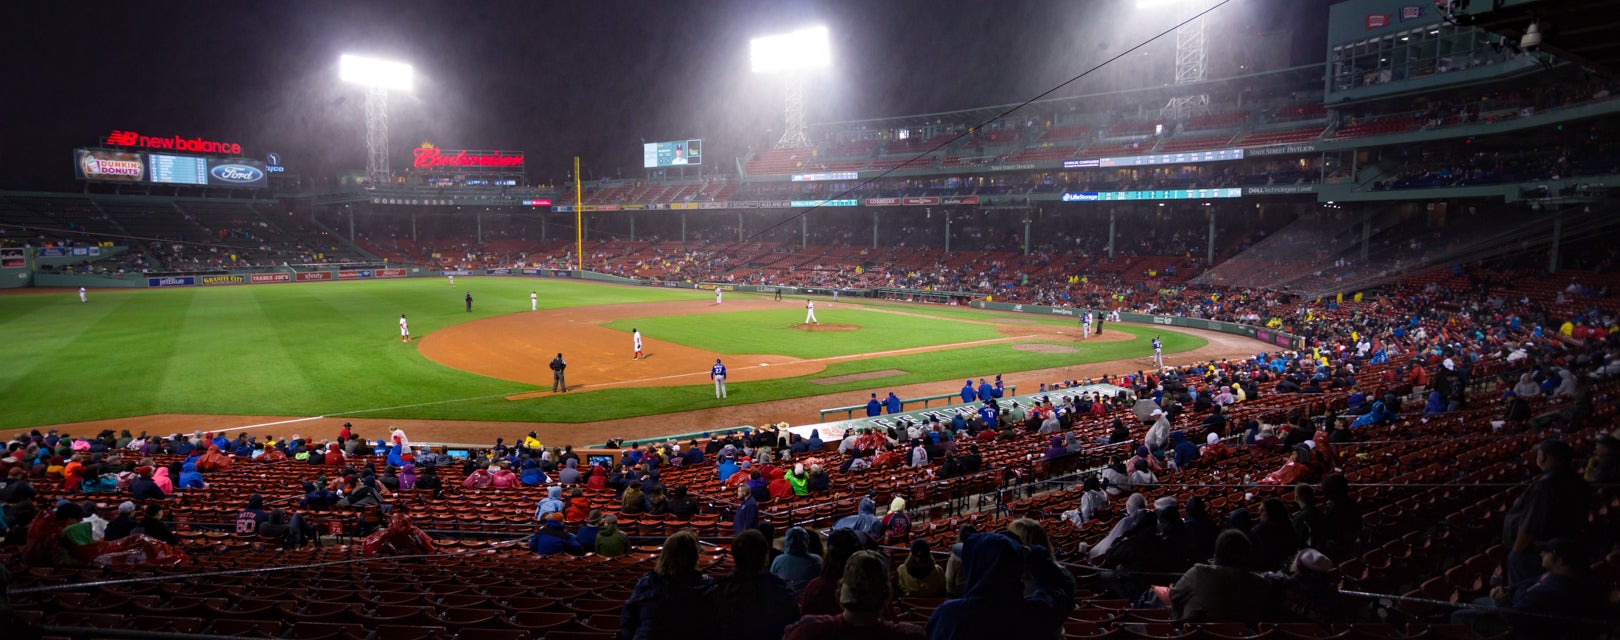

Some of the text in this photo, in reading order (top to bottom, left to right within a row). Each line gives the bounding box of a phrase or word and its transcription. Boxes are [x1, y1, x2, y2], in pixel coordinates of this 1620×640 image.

[139, 135, 175, 149] new
[175, 135, 241, 154] balance
[412, 147, 524, 168] Budweiser
[101, 160, 140, 169] DUNKIN'
[101, 167, 139, 176] DONUTS
[221, 167, 253, 181] Ford
[203, 276, 229, 284] GRANITE
[305, 272, 323, 280] xfinity
[160, 277, 185, 286] jetBlue
[236, 519, 256, 533] 50
